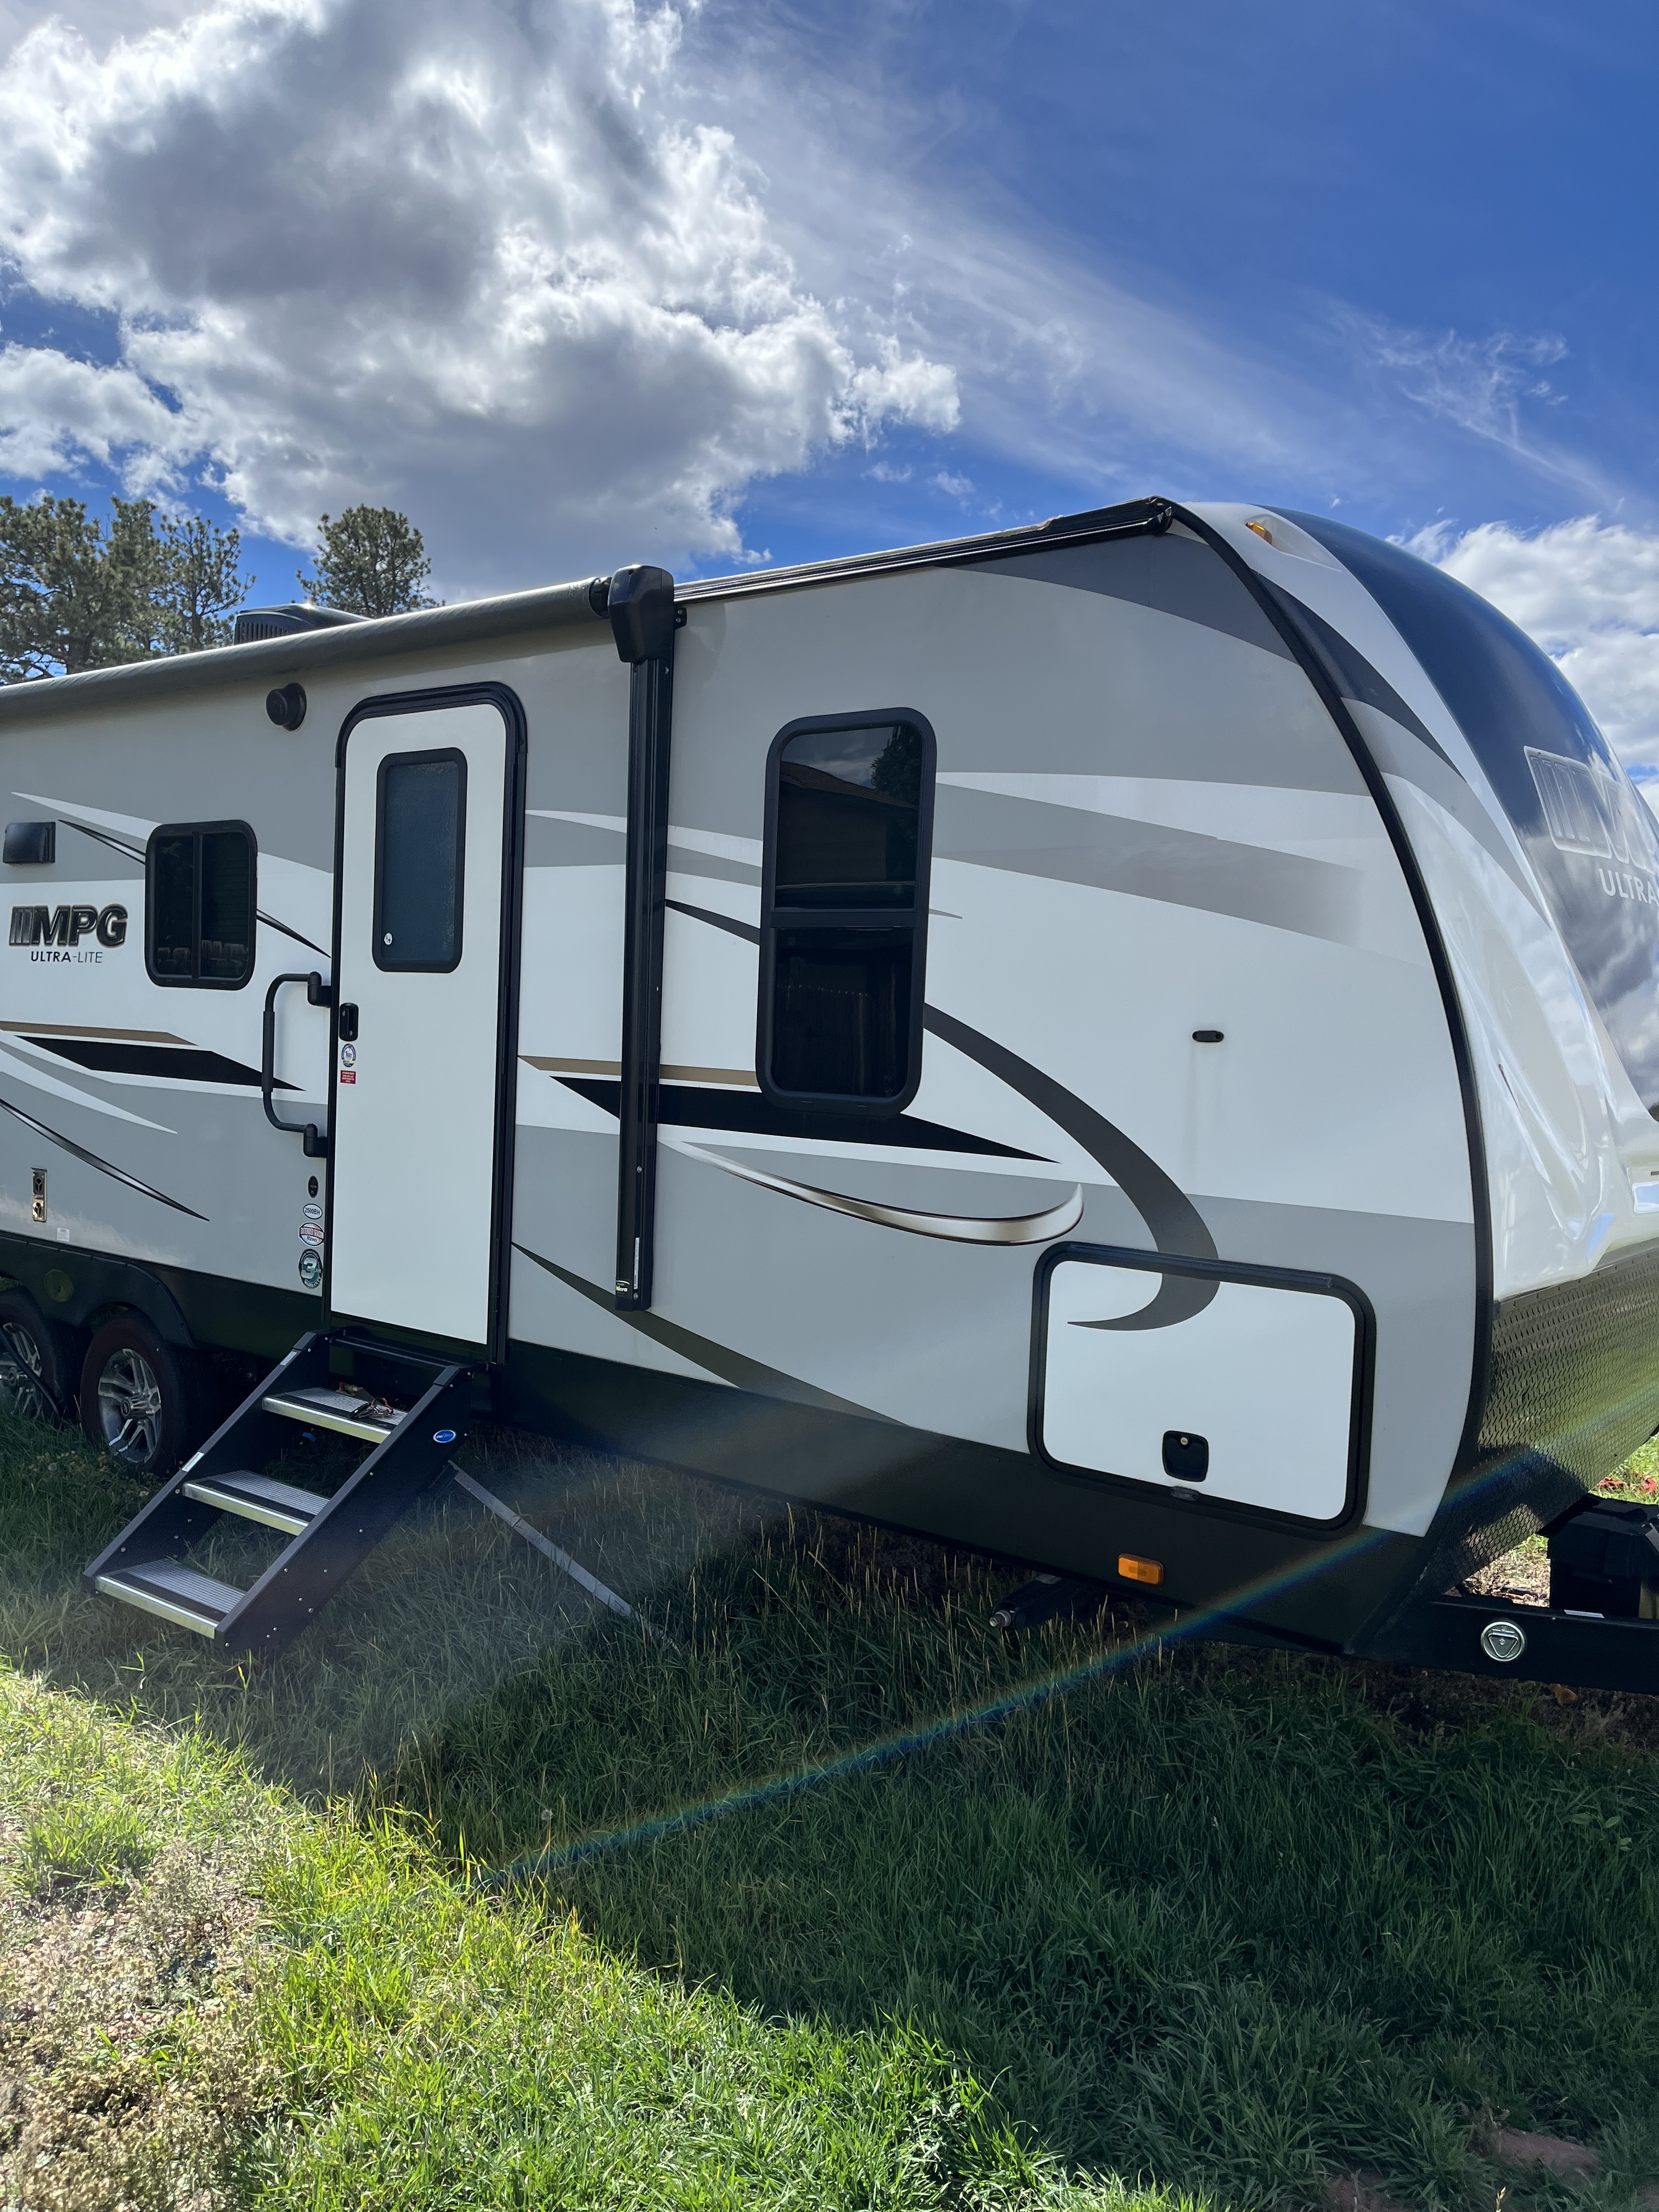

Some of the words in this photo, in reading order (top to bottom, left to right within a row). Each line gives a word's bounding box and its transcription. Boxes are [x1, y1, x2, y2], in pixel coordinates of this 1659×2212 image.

[31, 903, 128, 948] MPG
[31, 951, 103, 963] ULTRA-LITE
[301, 1257, 317, 1279] 3
